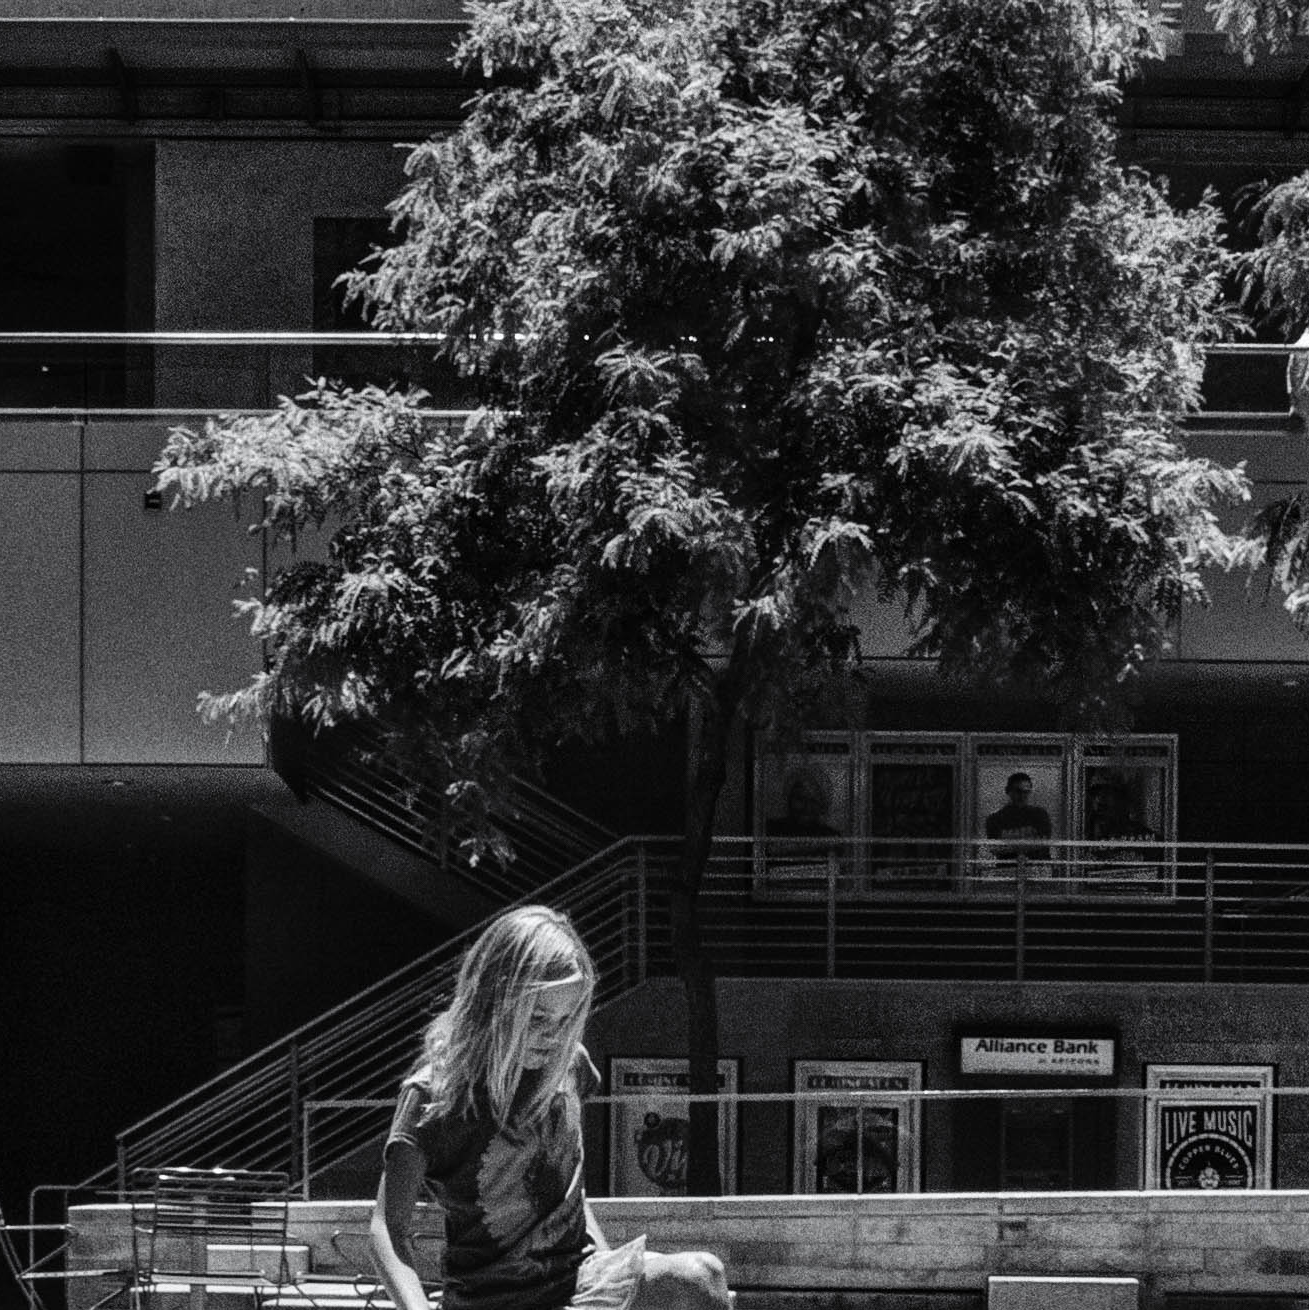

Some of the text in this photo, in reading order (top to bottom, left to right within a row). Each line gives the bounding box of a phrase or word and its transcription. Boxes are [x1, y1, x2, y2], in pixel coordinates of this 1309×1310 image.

[975, 1039, 1099, 1054] Alliance Bank
[1165, 1110, 1253, 1151] LIVE MUSIC
